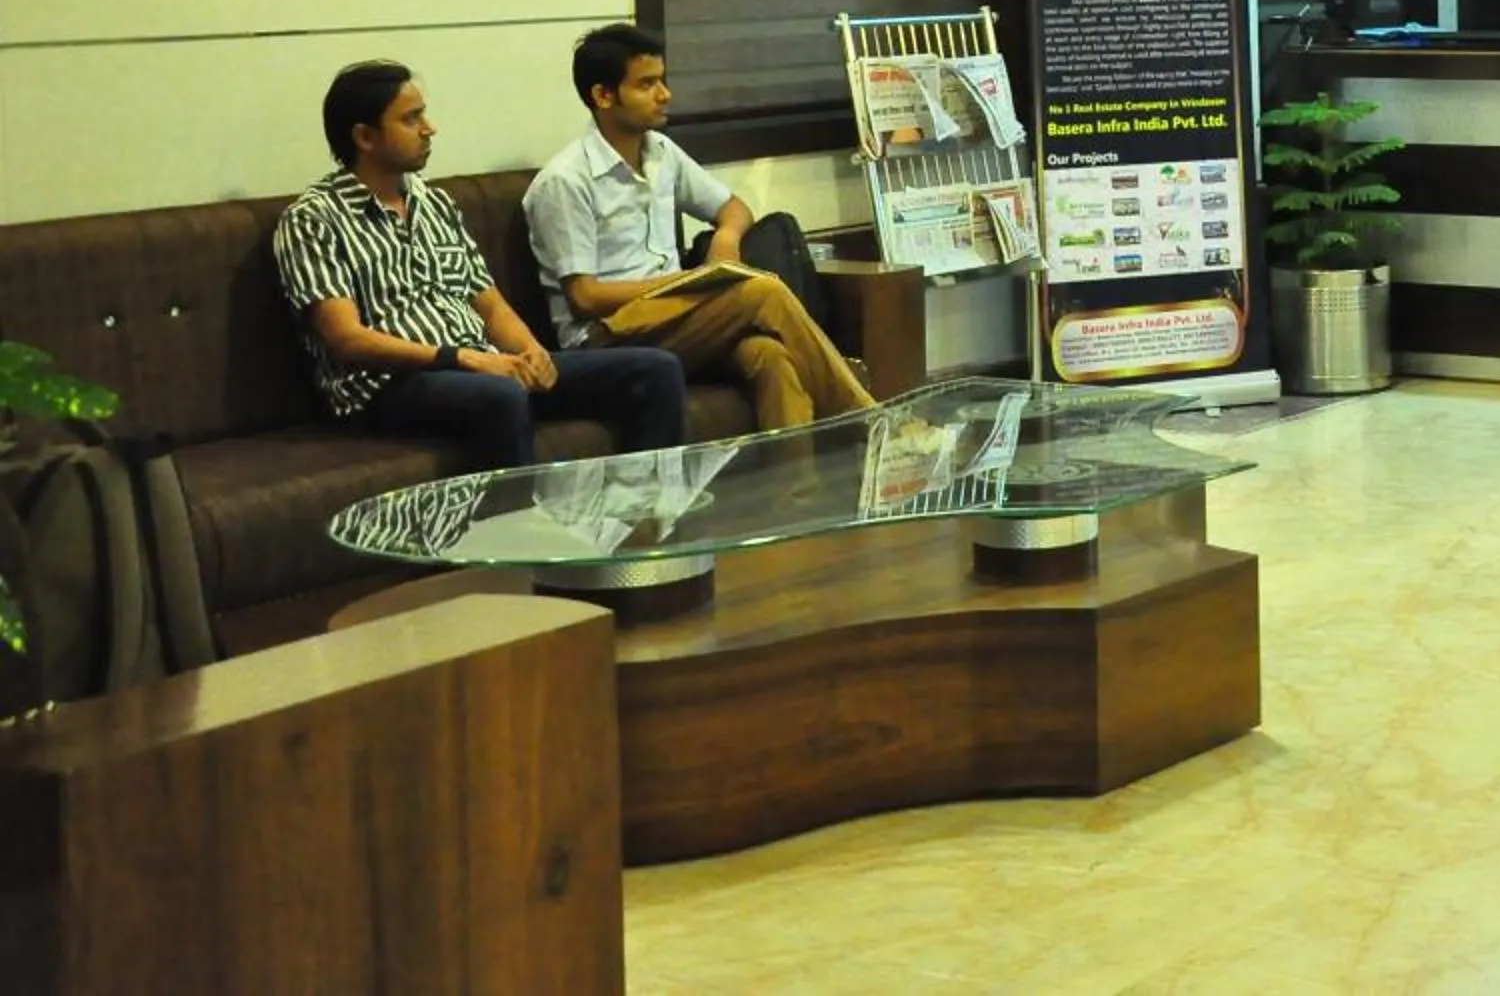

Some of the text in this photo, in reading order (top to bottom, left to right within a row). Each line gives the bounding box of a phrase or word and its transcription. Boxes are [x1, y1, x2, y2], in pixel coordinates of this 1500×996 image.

[1074, 103, 1093, 113] Real
[1095, 102, 1123, 112] Estate
[1125, 99, 1168, 112] Company
[1047, 113, 1228, 136] Basera Infra India Pvt. Ltd.
[1047, 151, 1119, 165] Our Projects
